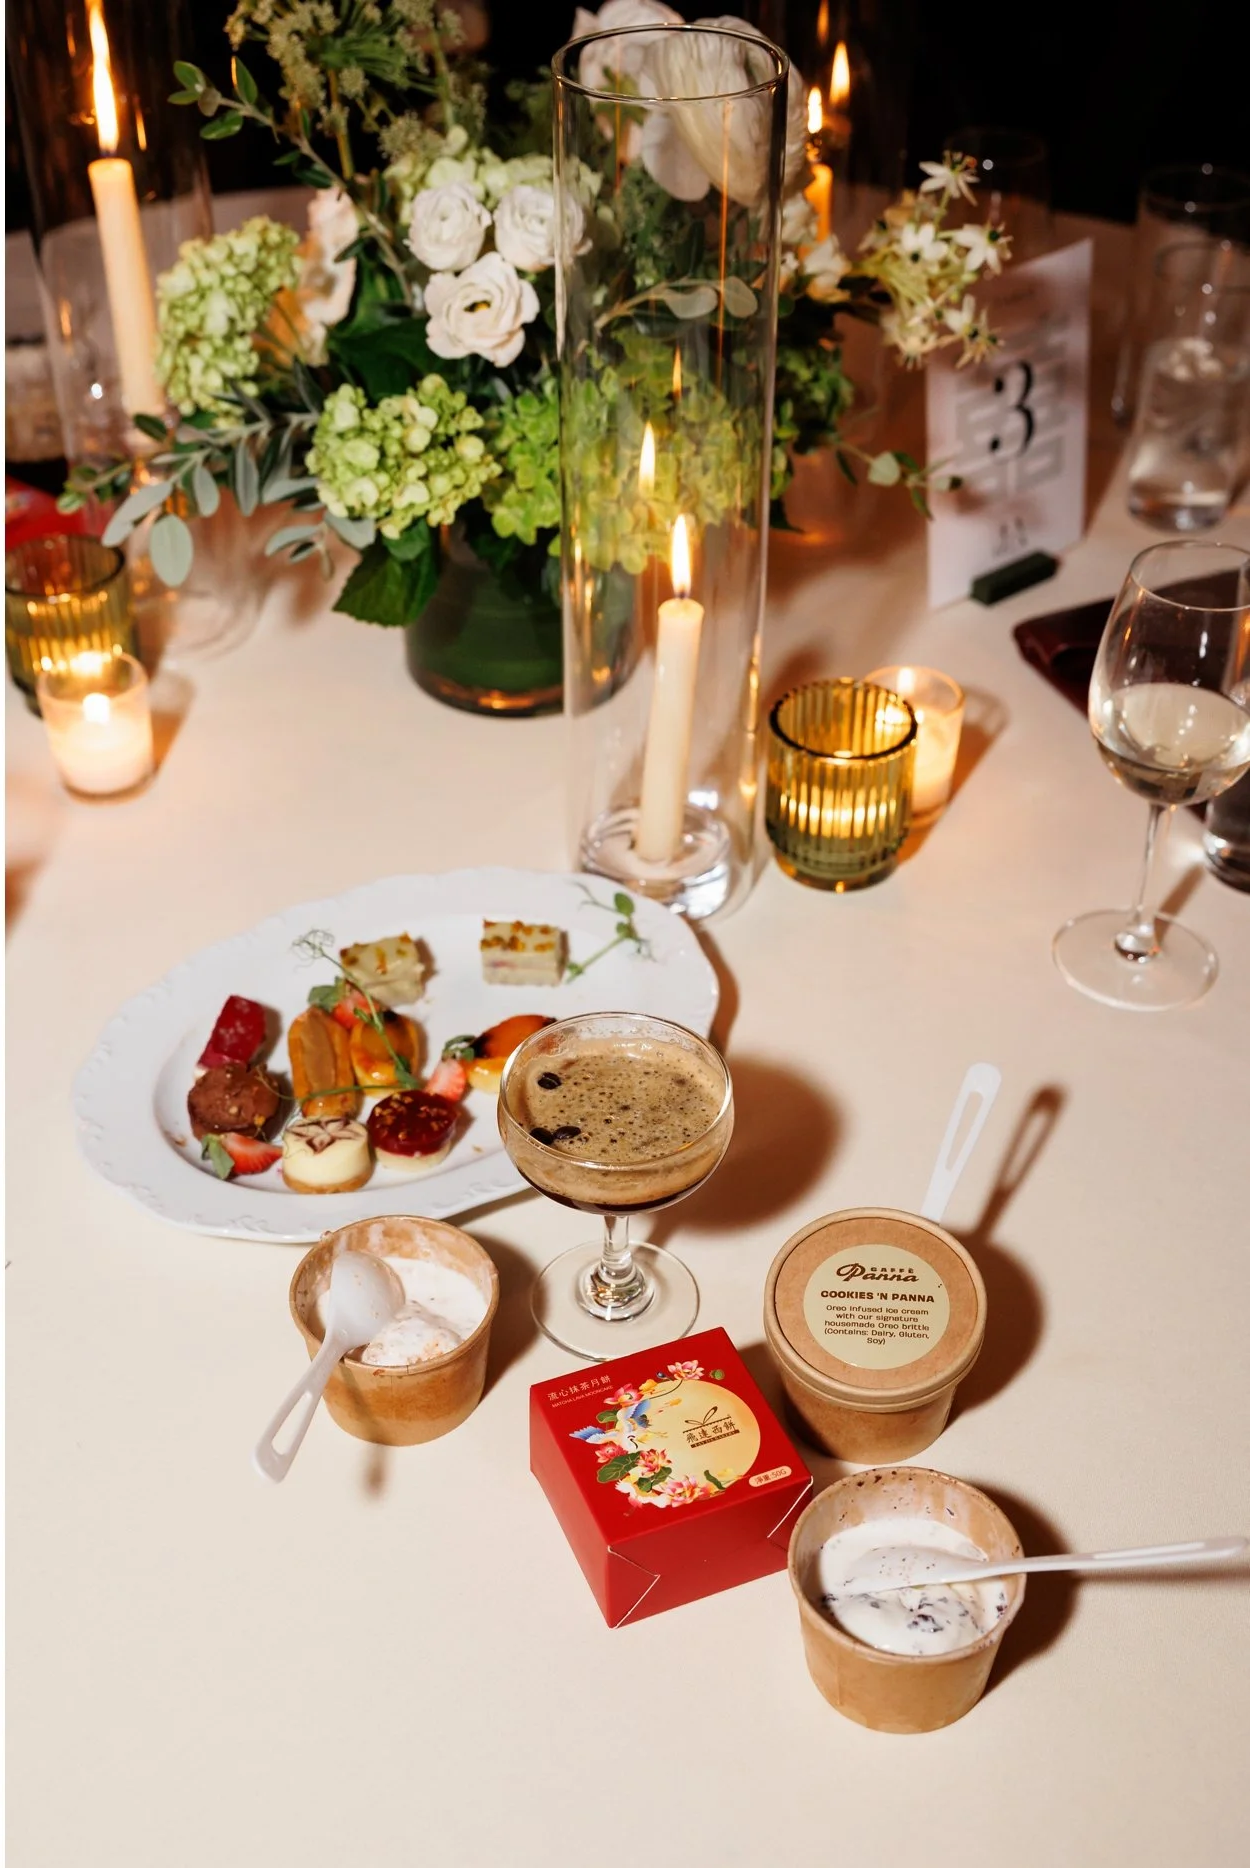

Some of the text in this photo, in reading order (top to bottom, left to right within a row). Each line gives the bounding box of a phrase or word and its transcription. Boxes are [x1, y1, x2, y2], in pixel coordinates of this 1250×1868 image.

[989, 360, 1035, 457] 3
[836, 1263, 919, 1281] Panna
[821, 1291, 873, 1300] COOKIES
[892, 1294, 934, 1303] PANNA
[876, 1315, 918, 1323] signature
[825, 1320, 929, 1331] housemade Oreo brittle
[824, 1327, 929, 1339] (Contains: Dairy, Gluten,
[867, 1337, 886, 1345] Soy)
